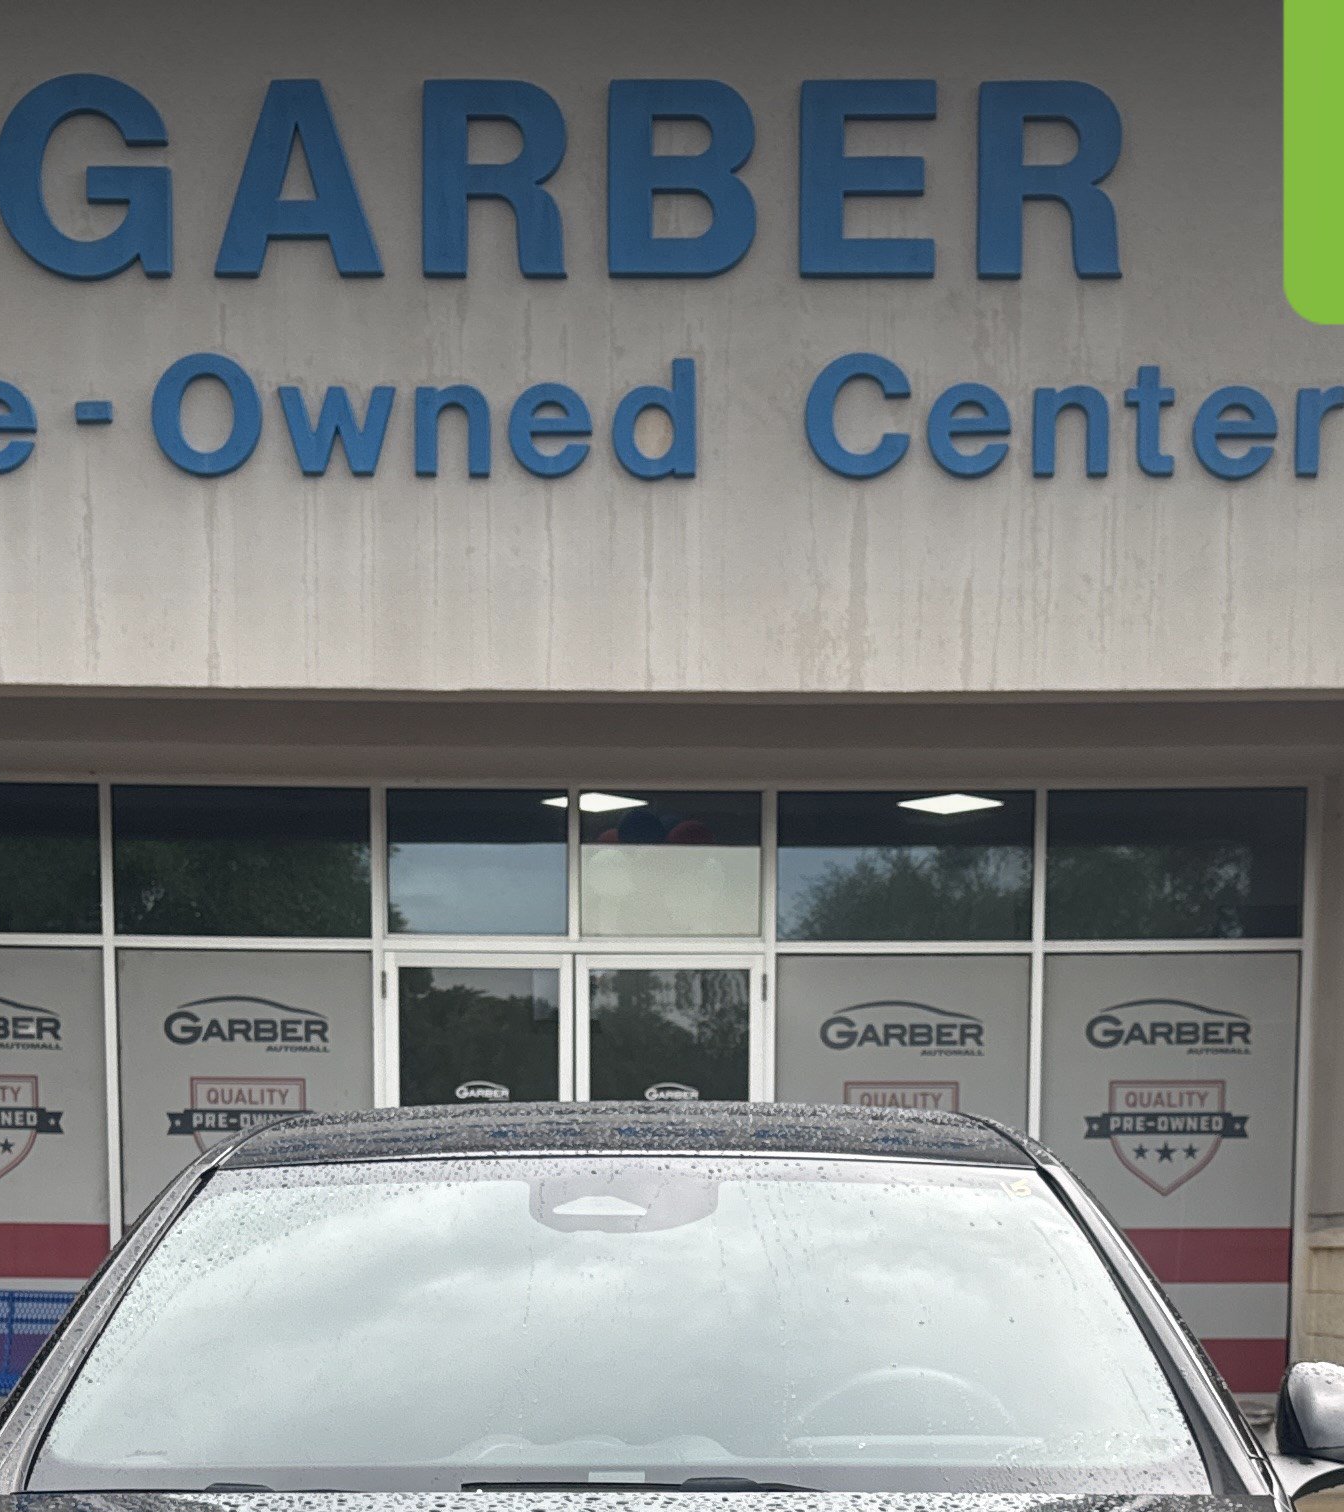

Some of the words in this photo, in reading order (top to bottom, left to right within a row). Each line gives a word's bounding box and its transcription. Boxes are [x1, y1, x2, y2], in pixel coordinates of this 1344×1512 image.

[164, 1011, 329, 1044] GARBER
[820, 1017, 984, 1050] GARBER
[1085, 1015, 1252, 1049] GARBER
[206, 1088, 289, 1105] QUALITY
[860, 1092, 943, 1109] QUALITY
[1124, 1091, 1209, 1108] QUALITY
[1109, 1116, 1223, 1131] PRE-OWNED
